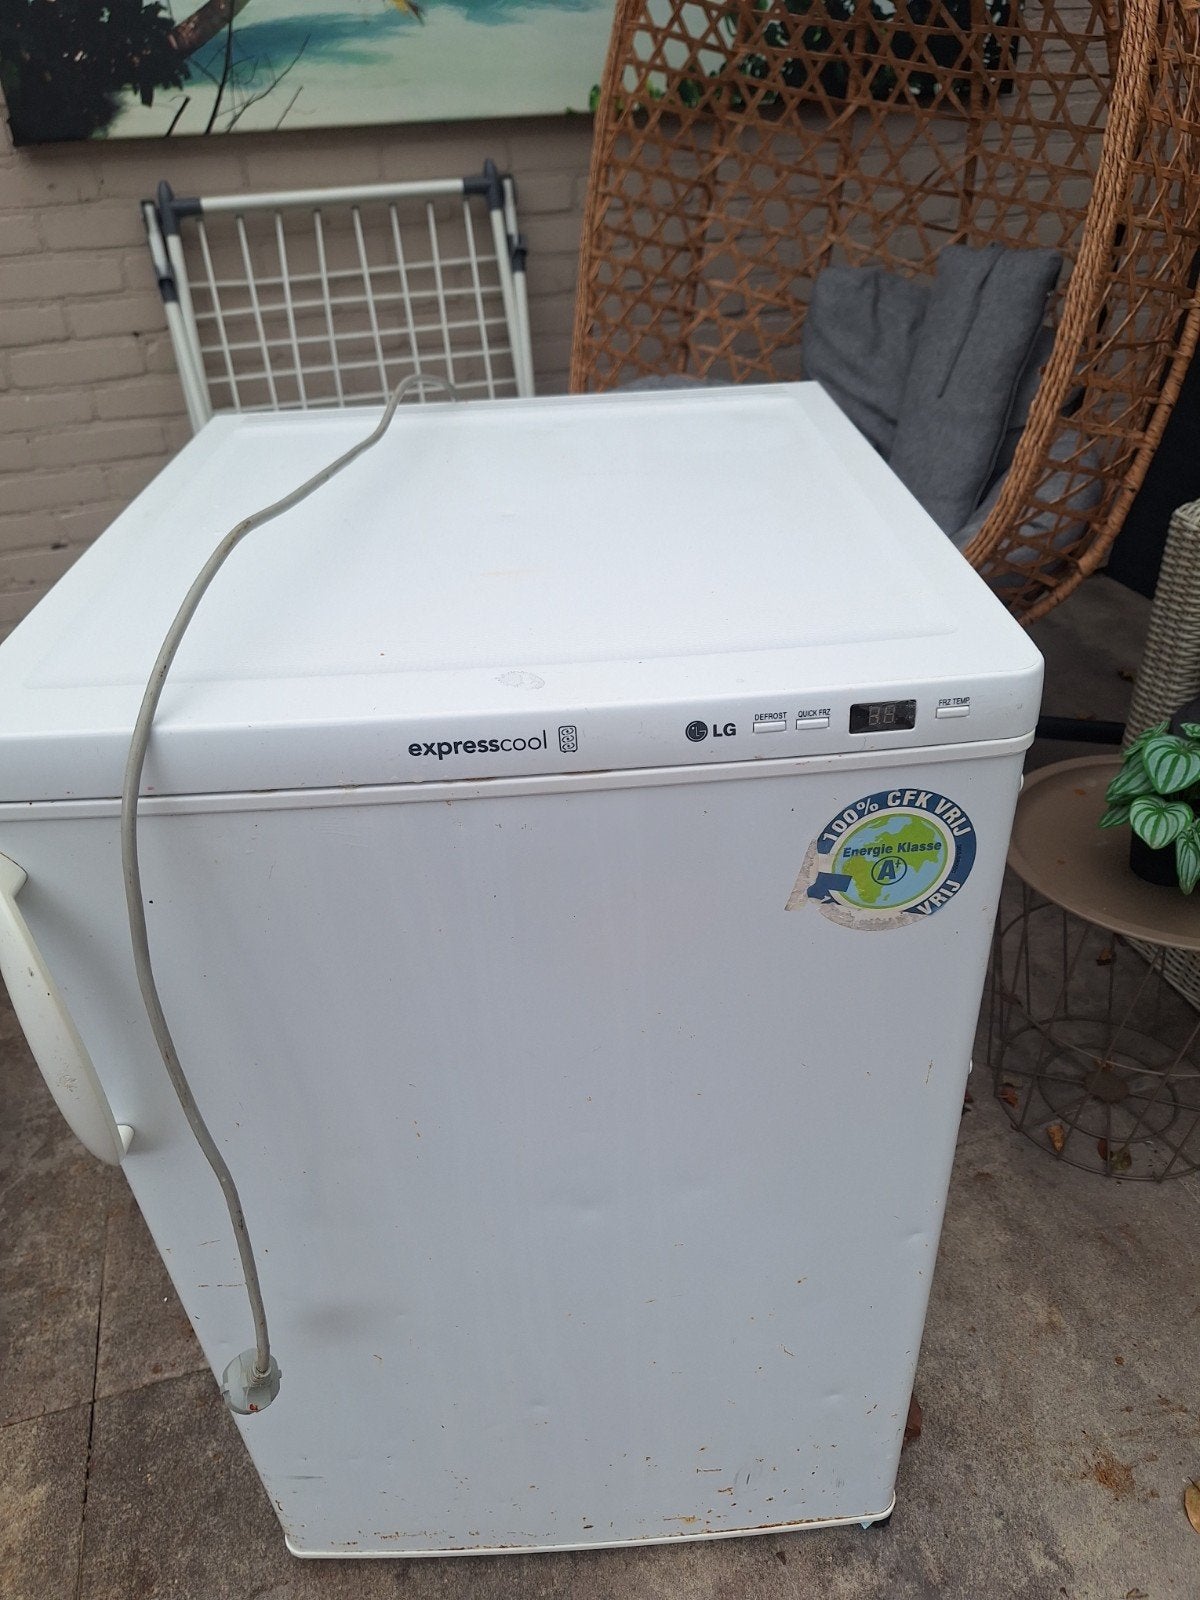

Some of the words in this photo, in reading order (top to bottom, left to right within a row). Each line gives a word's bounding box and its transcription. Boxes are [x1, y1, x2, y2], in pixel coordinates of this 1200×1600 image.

[939, 698, 951, 706] FRZ
[755, 711, 787, 721] DEFROST
[798, 709, 817, 718] QUICK
[818, 708, 831, 716] FRZ
[713, 722, 736, 737] LG
[408, 729, 547, 760] expresscool
[823, 797, 879, 843] 100%
[887, 789, 934, 808] CFK
[933, 797, 971, 837] VRIJ
[843, 845, 893, 859] Energie
[897, 840, 942, 854] Klasse
[916, 879, 961, 915] VRIJ
